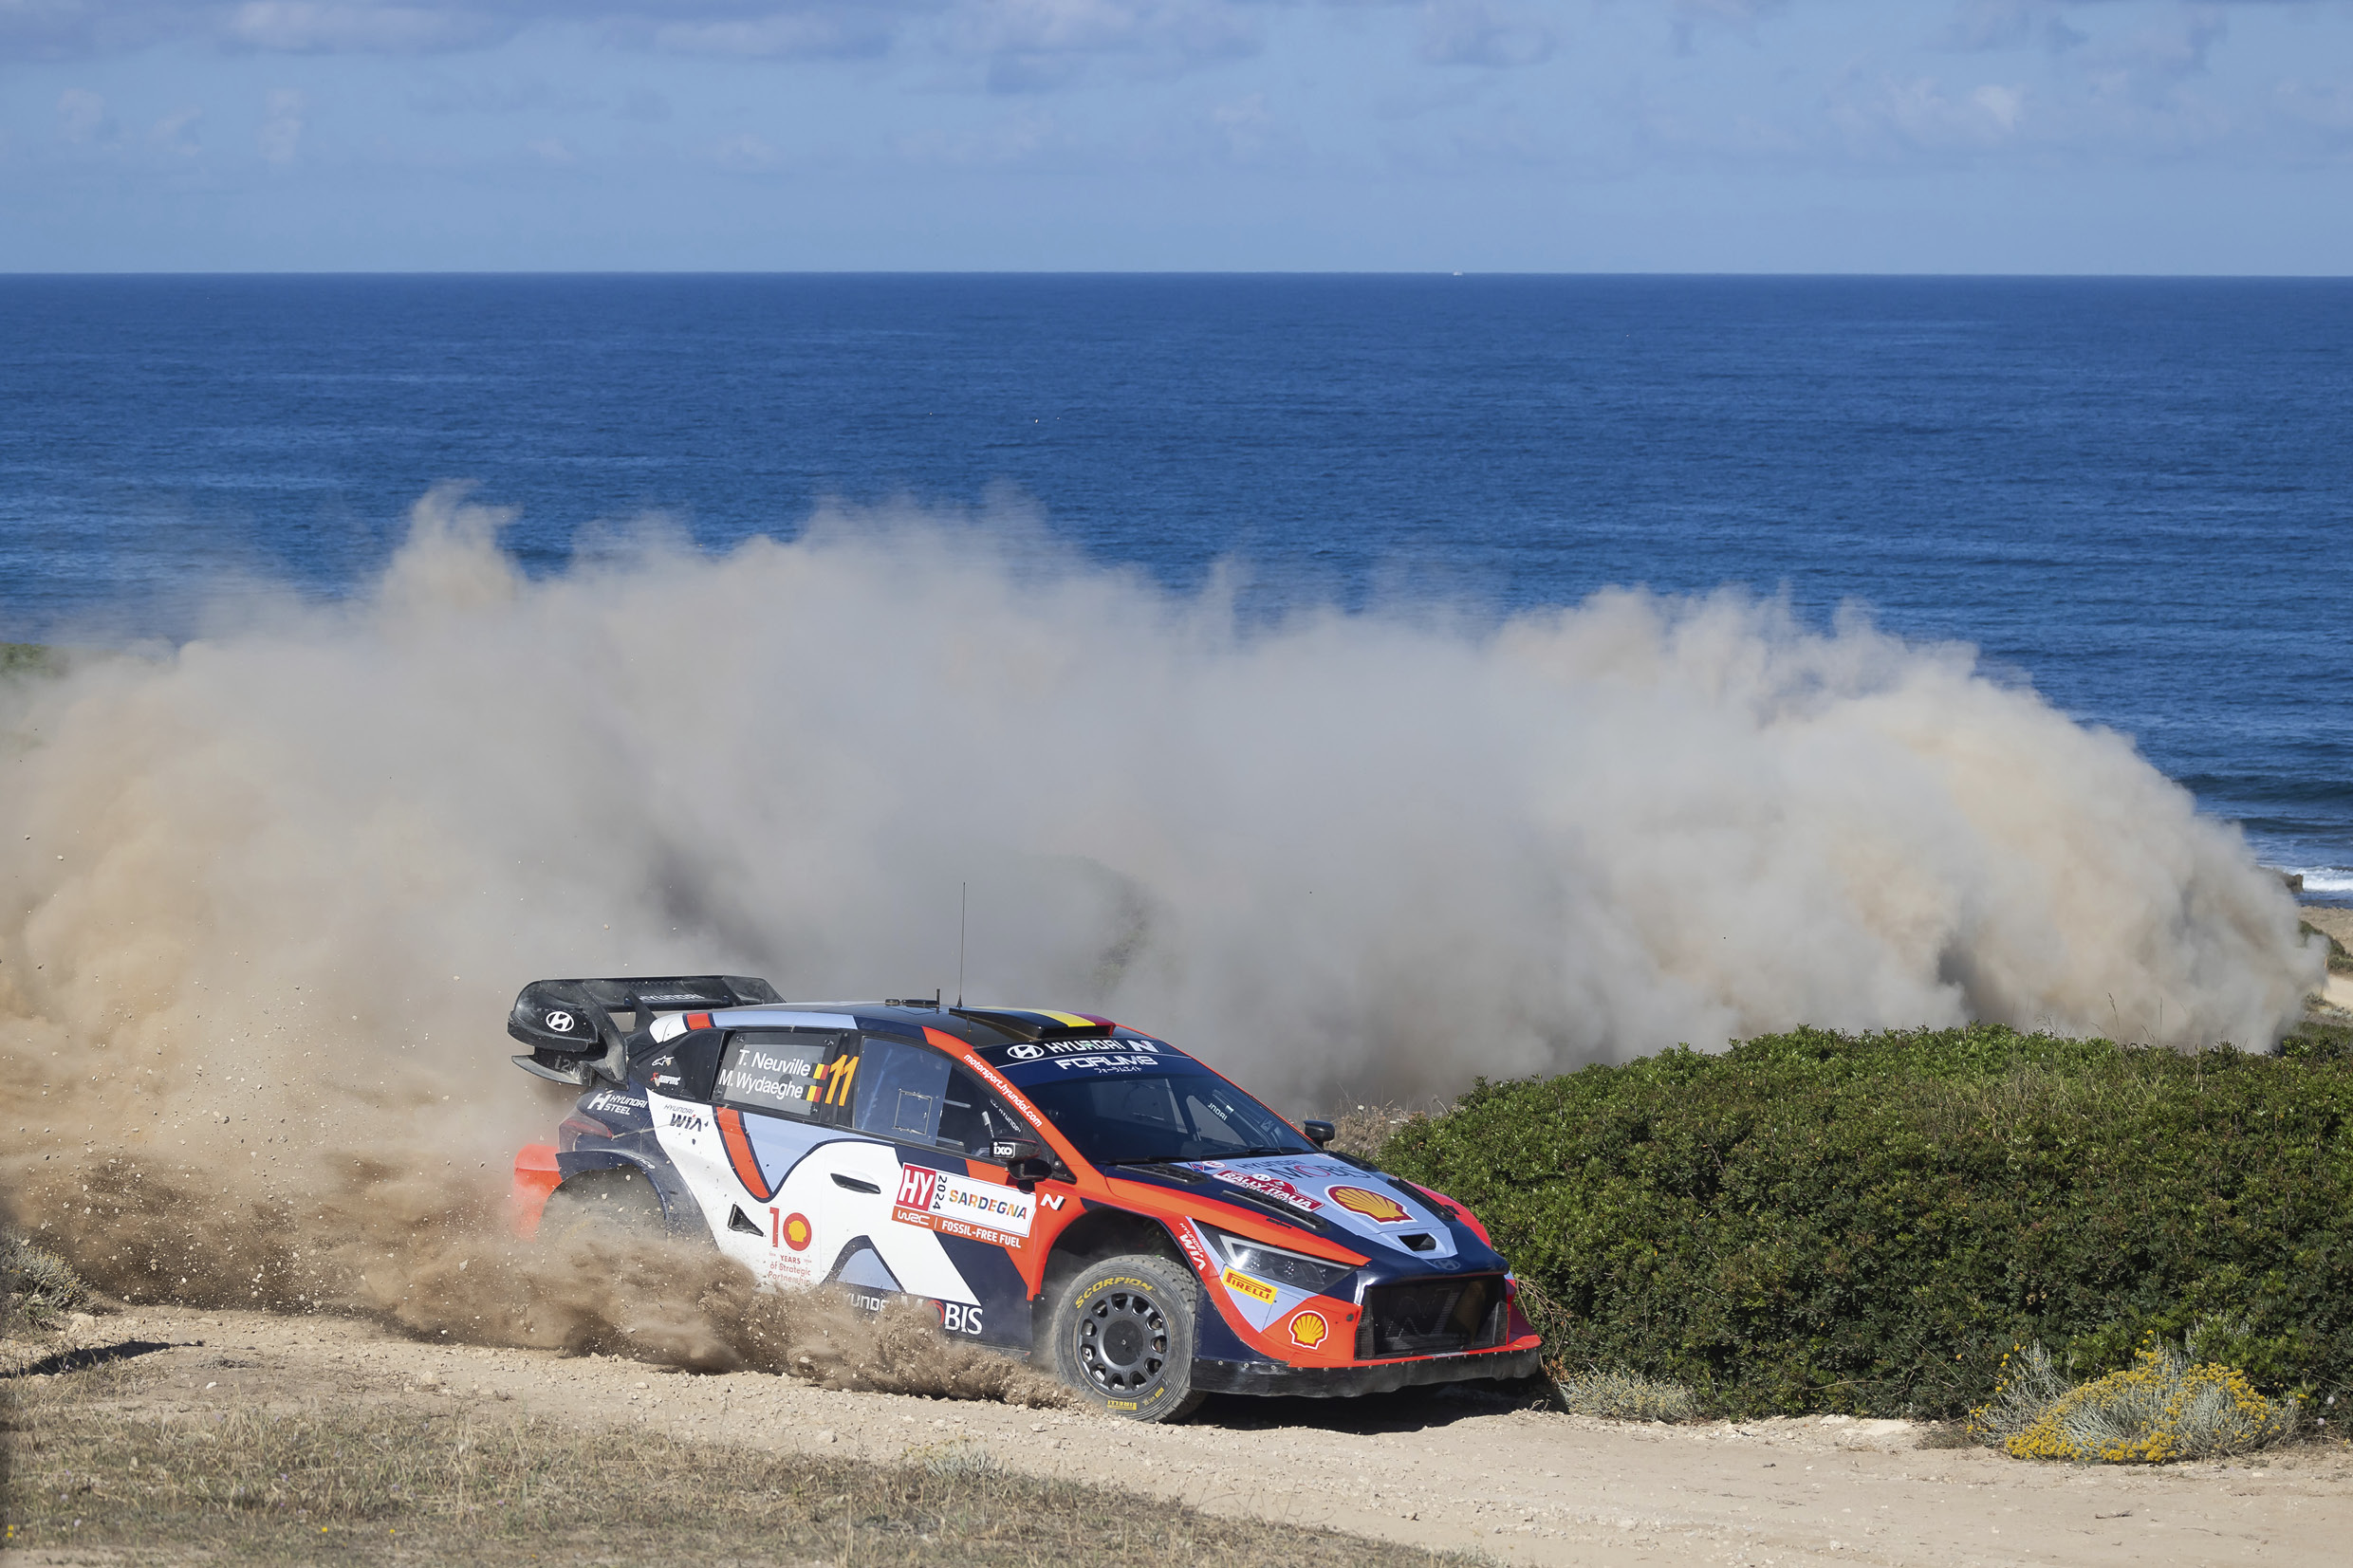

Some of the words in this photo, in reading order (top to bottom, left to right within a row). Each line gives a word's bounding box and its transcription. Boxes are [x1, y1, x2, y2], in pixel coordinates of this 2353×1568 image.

[1044, 1040, 1127, 1054] HYUNDAI
[737, 1049, 750, 1066] T.
[750, 1052, 811, 1078] Neuville
[718, 1069, 734, 1088] M.
[735, 1071, 804, 1100] Wydaeghe
[824, 1054, 860, 1107] 11
[963, 1054, 1043, 1128] motorsport.hyundai.com
[603, 1103, 631, 1116] STEEL
[609, 1095, 648, 1109] HYUNDAI
[663, 1104, 695, 1115] HYUNDAI
[1265, 1165, 1372, 1180] MOBIS
[898, 1169, 935, 1207] HY
[933, 1174, 948, 1210] 2024
[1040, 1192, 1066, 1210] N
[1221, 1172, 1268, 1189] RALLY
[1266, 1187, 1312, 1208] ITALIA
[949, 1190, 1028, 1220] SARDEGNA
[898, 1209, 931, 1226] WRC
[941, 1220, 998, 1243] FOSSIL-FREE
[999, 1234, 1022, 1248] FUEL
[1179, 1223, 1204, 1253] HYUNDAI
[779, 1263, 811, 1277] Strategic
[780, 1254, 801, 1264] YEARS
[1075, 1277, 1153, 1309] SCORPION
[1226, 1272, 1272, 1300] PIRELLI
